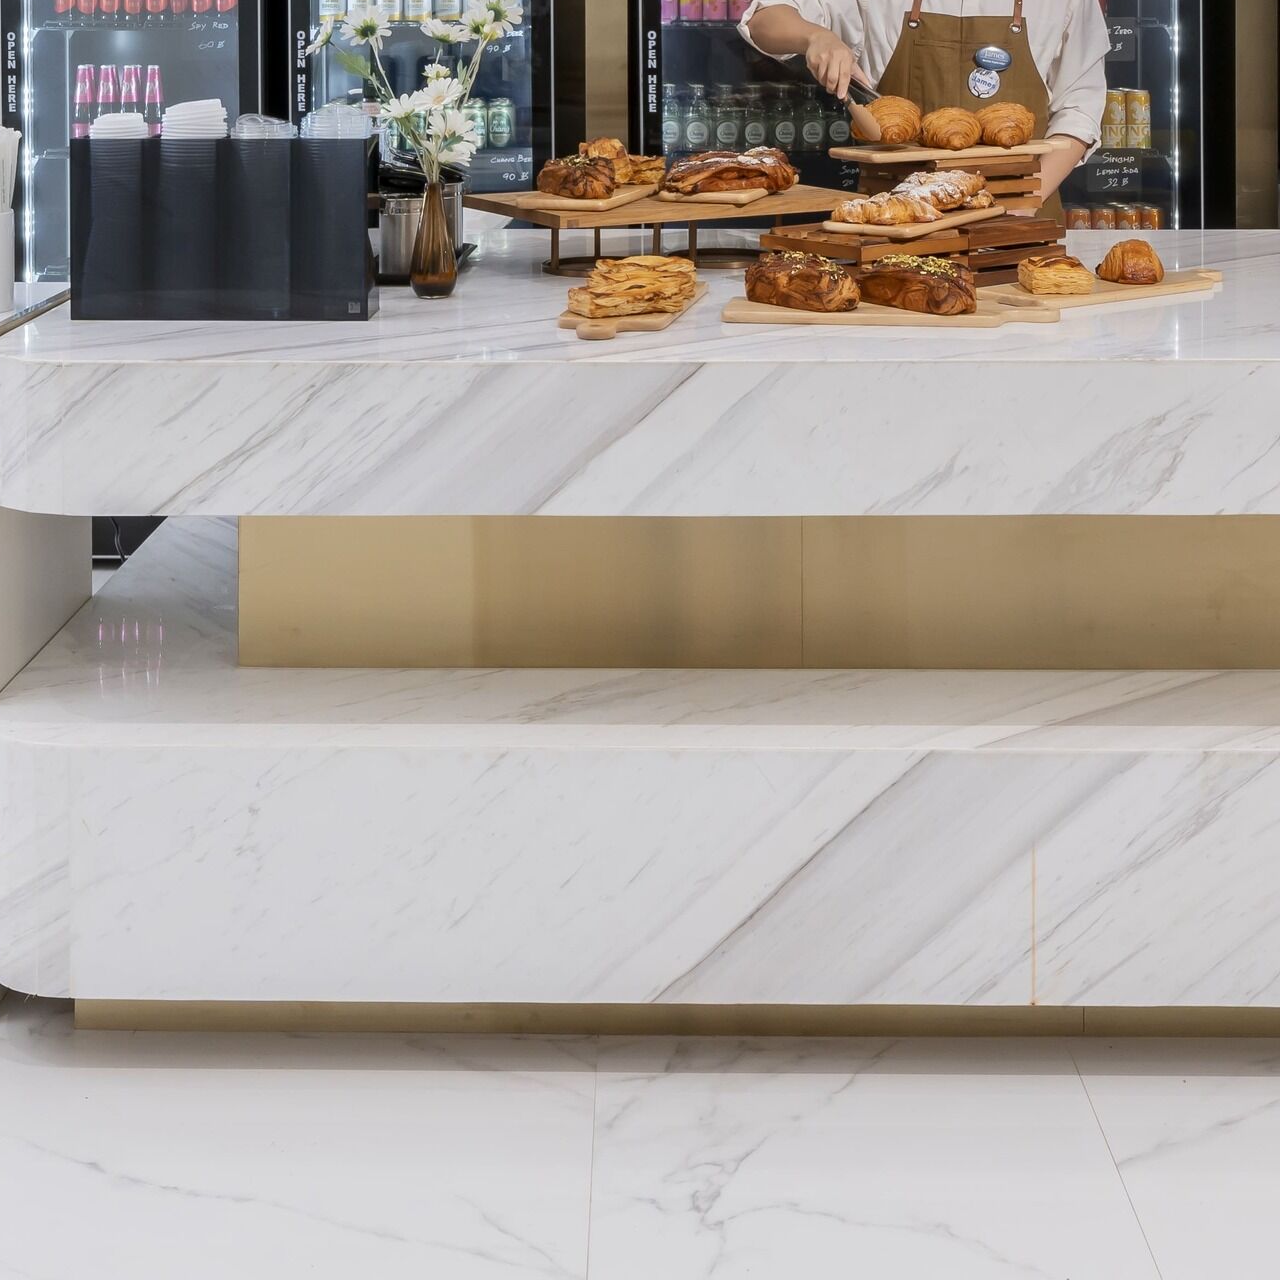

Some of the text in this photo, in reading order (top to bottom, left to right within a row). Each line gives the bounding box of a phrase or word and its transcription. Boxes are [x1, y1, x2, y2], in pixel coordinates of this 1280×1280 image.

[297, 31, 305, 68] OPEN
[648, 31, 656, 68] OPEN
[7, 32, 16, 112] OPEN HERE
[1103, 178, 1118, 189] 32
